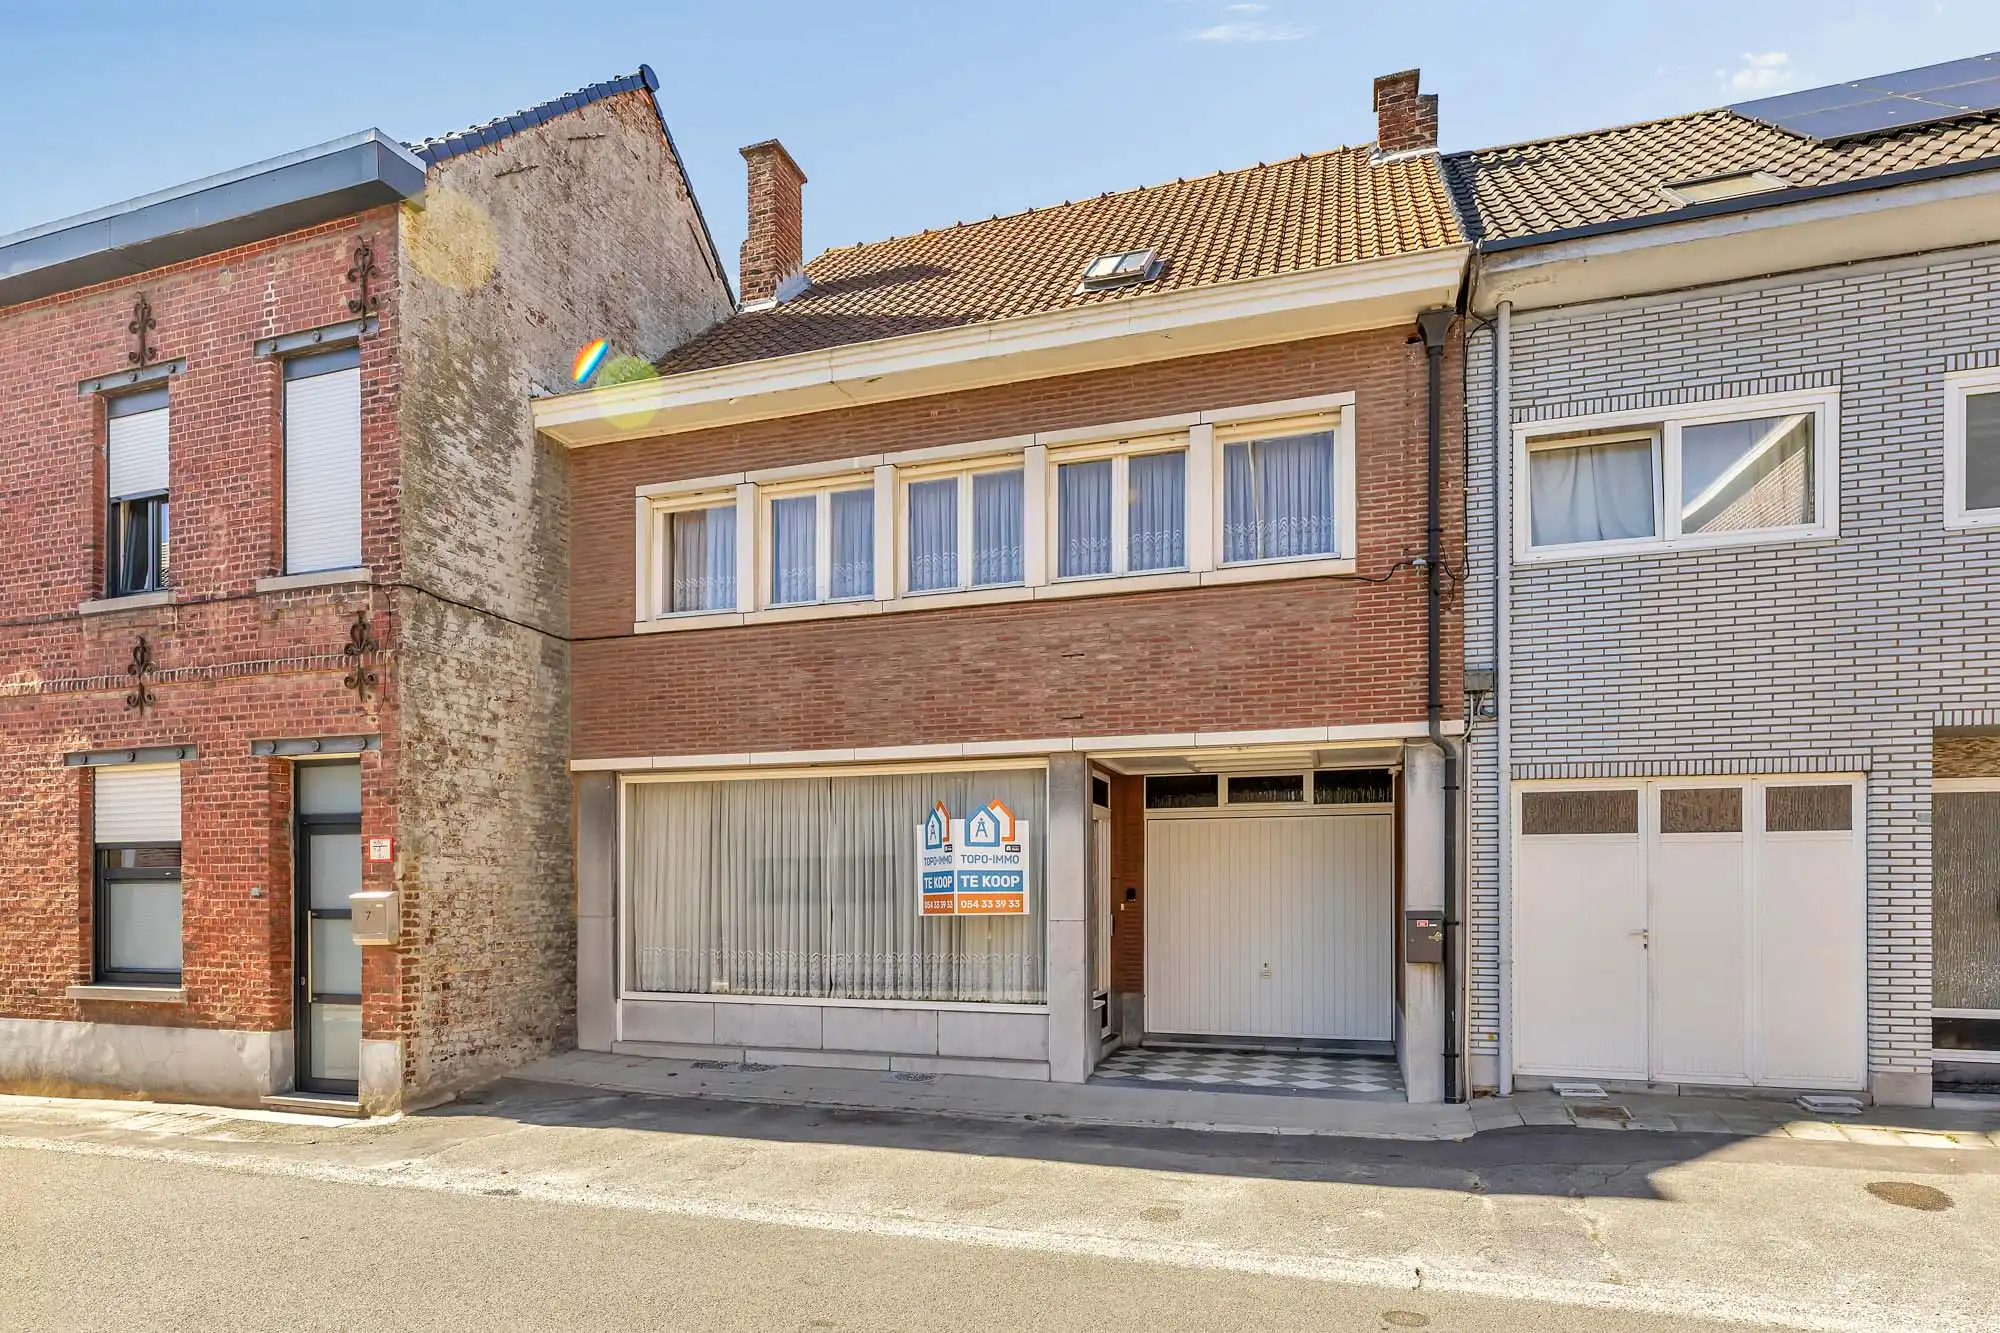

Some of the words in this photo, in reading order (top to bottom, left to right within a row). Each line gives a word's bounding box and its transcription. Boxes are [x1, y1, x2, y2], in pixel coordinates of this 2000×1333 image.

[924, 855, 952, 866] TOPO-IMMO
[960, 854, 1020, 864] TOPO-IMMO
[924, 877, 933, 889] TE
[933, 876, 952, 888] KOOP
[960, 875, 979, 888] TE
[982, 875, 1020, 888] KOOP
[946, 900, 953, 908] 33
[960, 900, 979, 908] 054
[981, 900, 993, 908] 33
[995, 900, 1007, 908] 39
[1008, 900, 1020, 908] 33
[366, 911, 371, 920] 7
